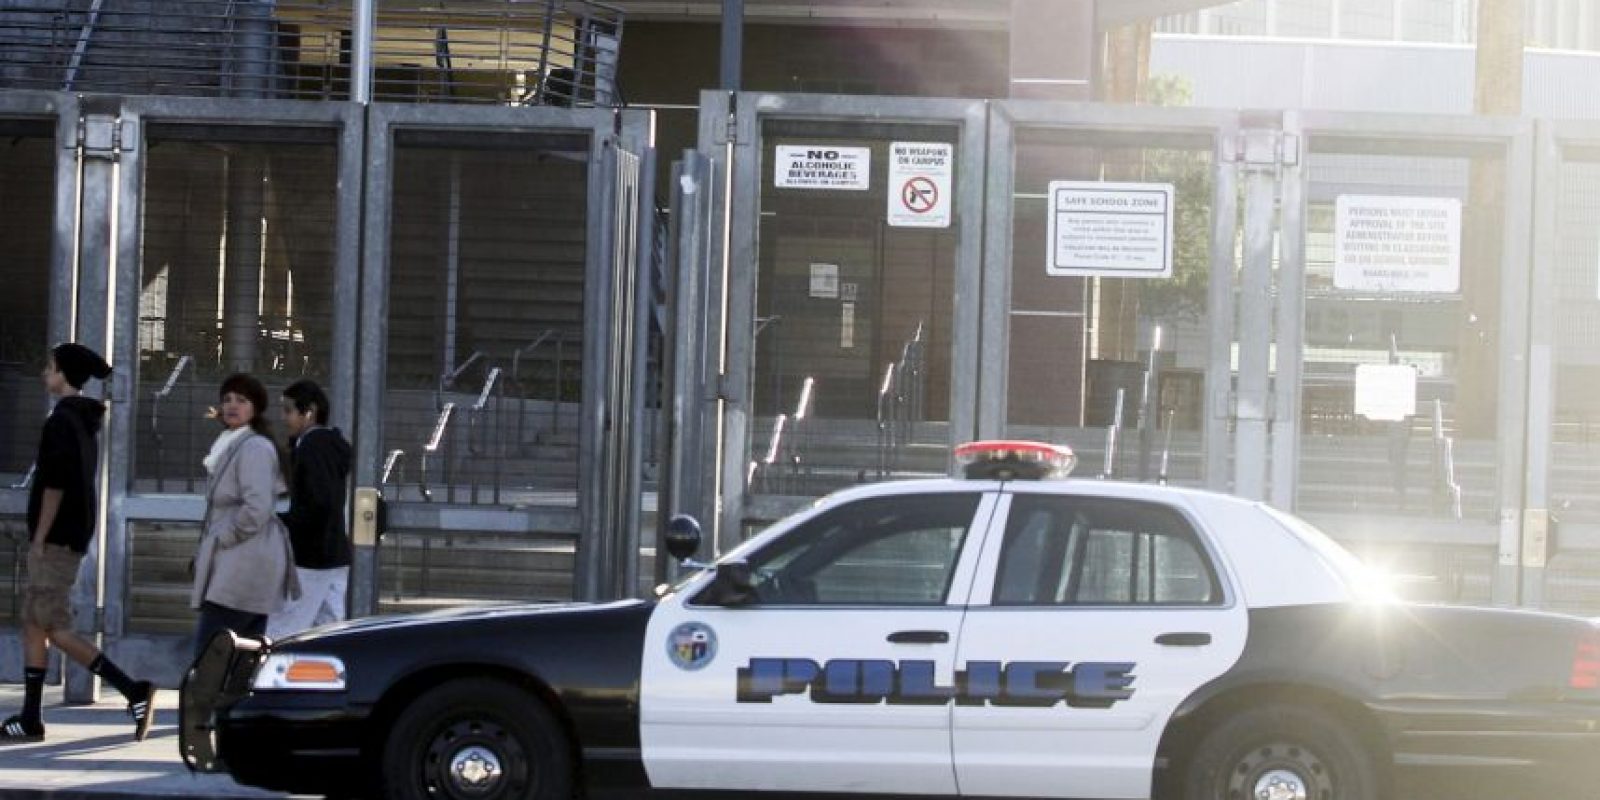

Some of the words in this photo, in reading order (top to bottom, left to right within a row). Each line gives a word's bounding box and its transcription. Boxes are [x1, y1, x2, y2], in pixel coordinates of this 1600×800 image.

[807, 150, 840, 160] NO
[895, 147, 907, 155] NO
[910, 148, 948, 157] WEAPONS
[792, 161, 856, 170] ALCOHOLIC
[898, 156, 909, 165] ON
[911, 157, 945, 166] CAMPUS
[788, 170, 857, 180] BEVERAGES
[1064, 197, 1087, 206] SAFE
[1090, 197, 1129, 206] SCHOOL
[1131, 198, 1159, 207] ZONE
[1348, 207, 1387, 217] PERSONS
[1350, 219, 1392, 229] APPROVAL
[736, 657, 1137, 708] POLICE
